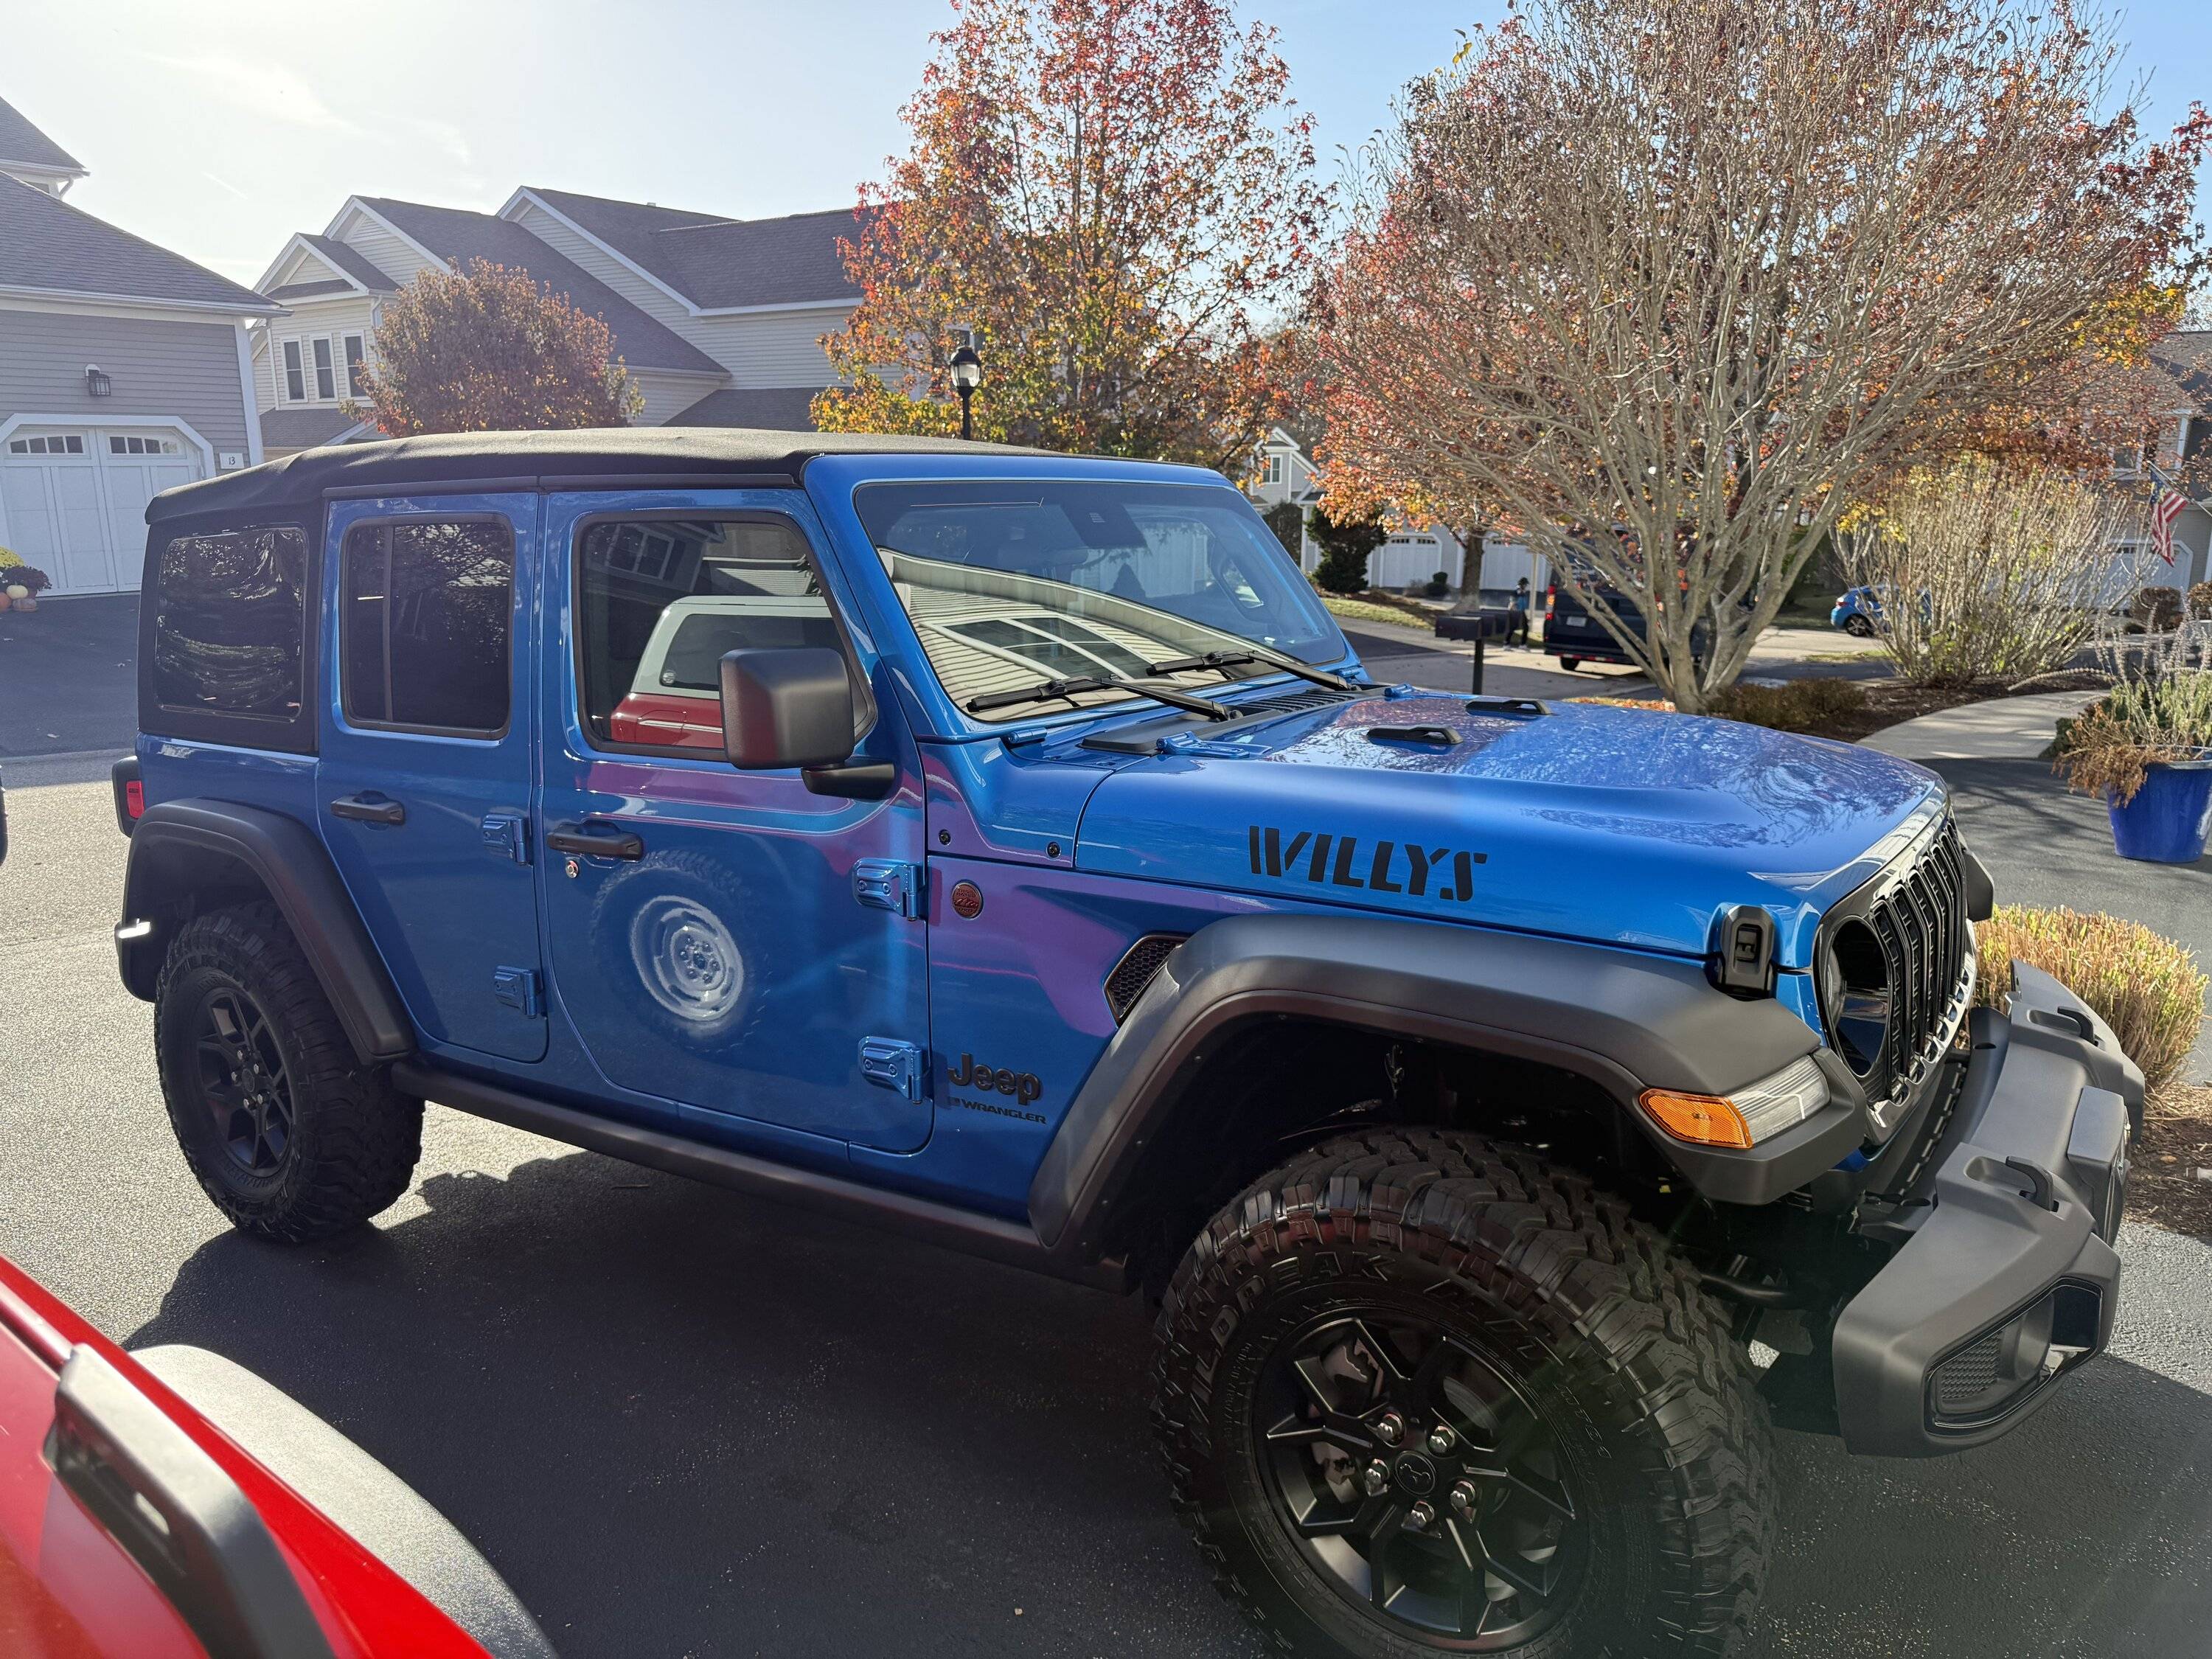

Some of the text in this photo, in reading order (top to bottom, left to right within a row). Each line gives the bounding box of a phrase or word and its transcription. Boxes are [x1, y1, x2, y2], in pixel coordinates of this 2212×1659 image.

[229, 456, 236, 465] 13
[1249, 825, 1488, 902] WILLYS
[947, 1052, 1042, 1105] Jeep
[961, 1099, 1047, 1124] WRANGLER
